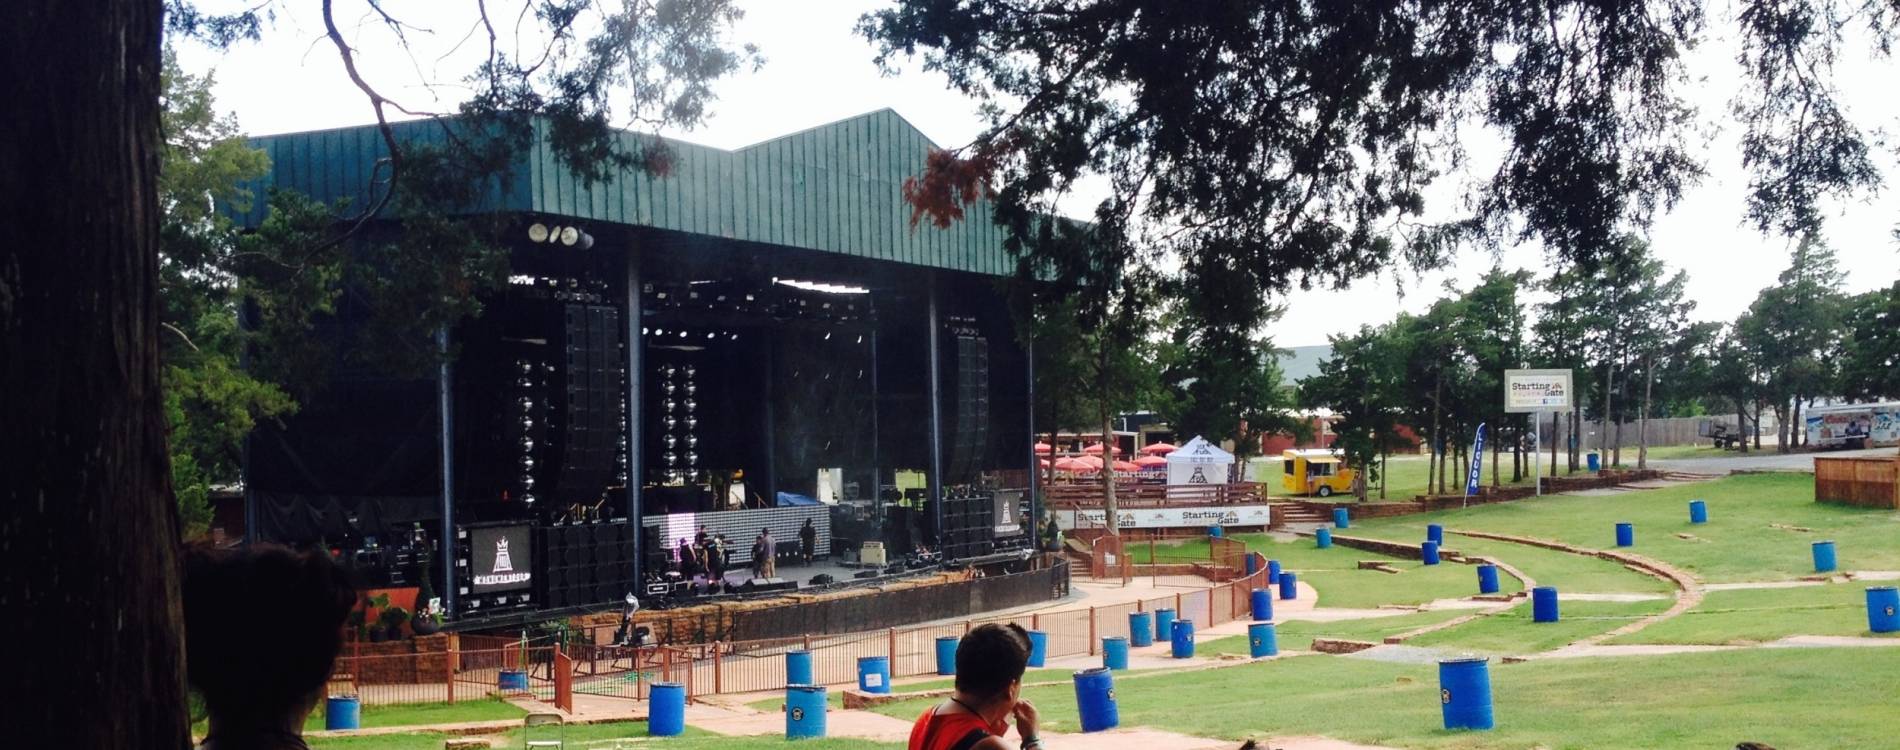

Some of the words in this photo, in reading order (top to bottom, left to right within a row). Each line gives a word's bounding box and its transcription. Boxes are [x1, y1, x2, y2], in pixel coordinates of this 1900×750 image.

[1512, 382, 1550, 391] Starting
[1544, 389, 1564, 397] Gate
[1471, 432, 1483, 488] LIQUOR
[1182, 511, 1225, 520] Starting
[1217, 516, 1239, 525] Gate
